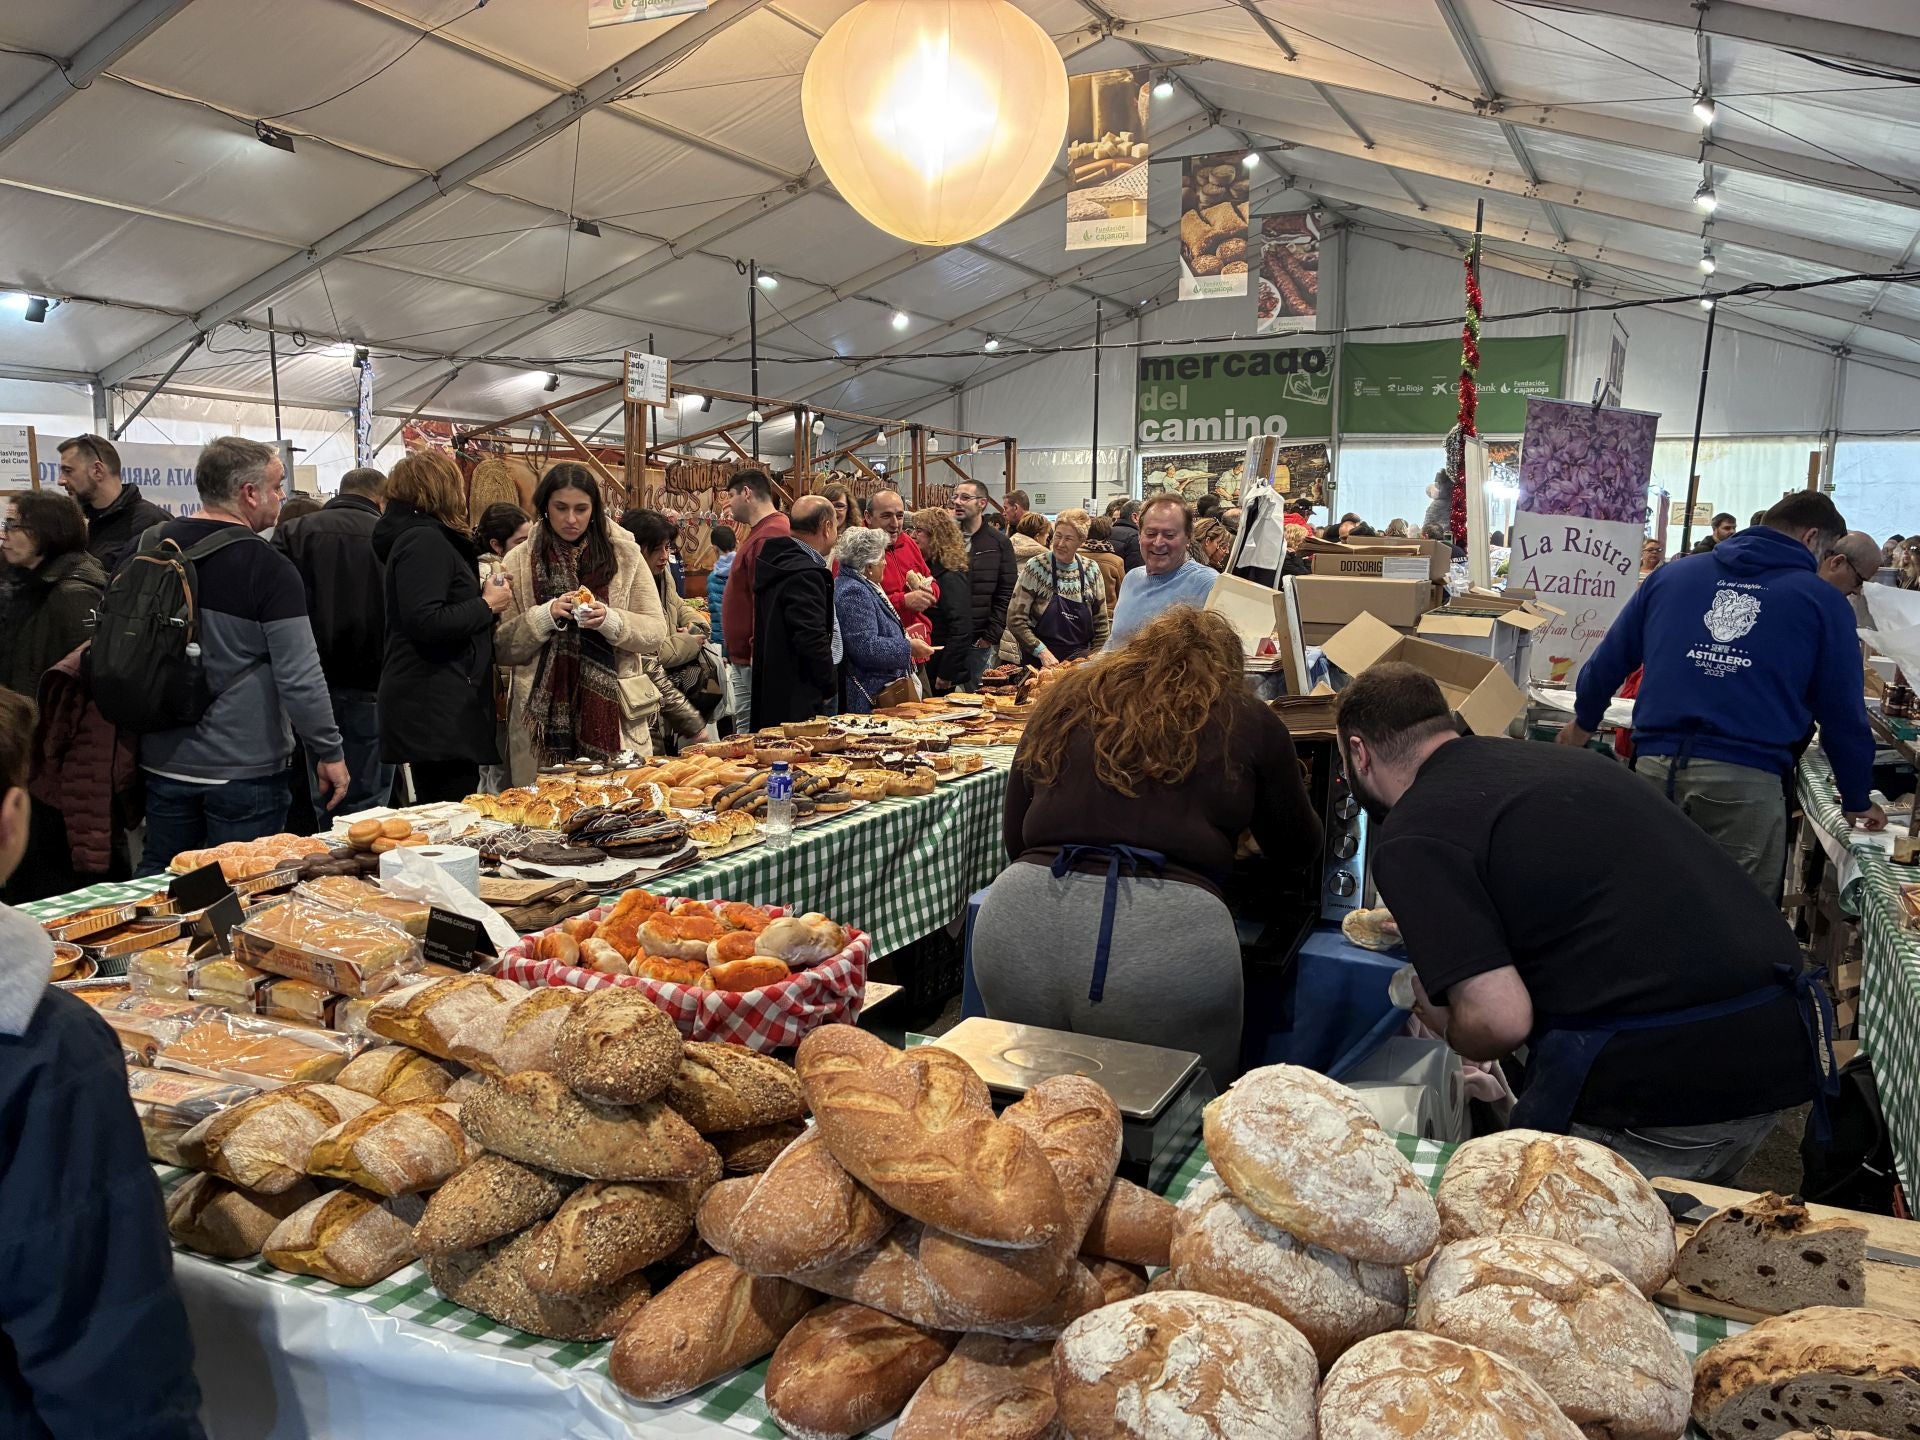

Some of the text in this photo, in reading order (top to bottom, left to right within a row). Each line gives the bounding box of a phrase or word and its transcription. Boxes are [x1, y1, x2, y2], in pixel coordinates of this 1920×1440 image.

[1140, 348, 1327, 381] mercado
[1139, 384, 1188, 411] del
[1397, 384, 1424, 393] La Rioja
[1138, 408, 1288, 442] camino
[1518, 526, 1633, 576] La Ristra
[1523, 565, 1617, 598] Azafrán
[1686, 649, 1753, 667] ASTILLERO
[1694, 660, 1738, 673] SAN JOSÉ
[1703, 668, 1725, 678] 2023
[432, 910, 476, 932] Sobaos caseros
